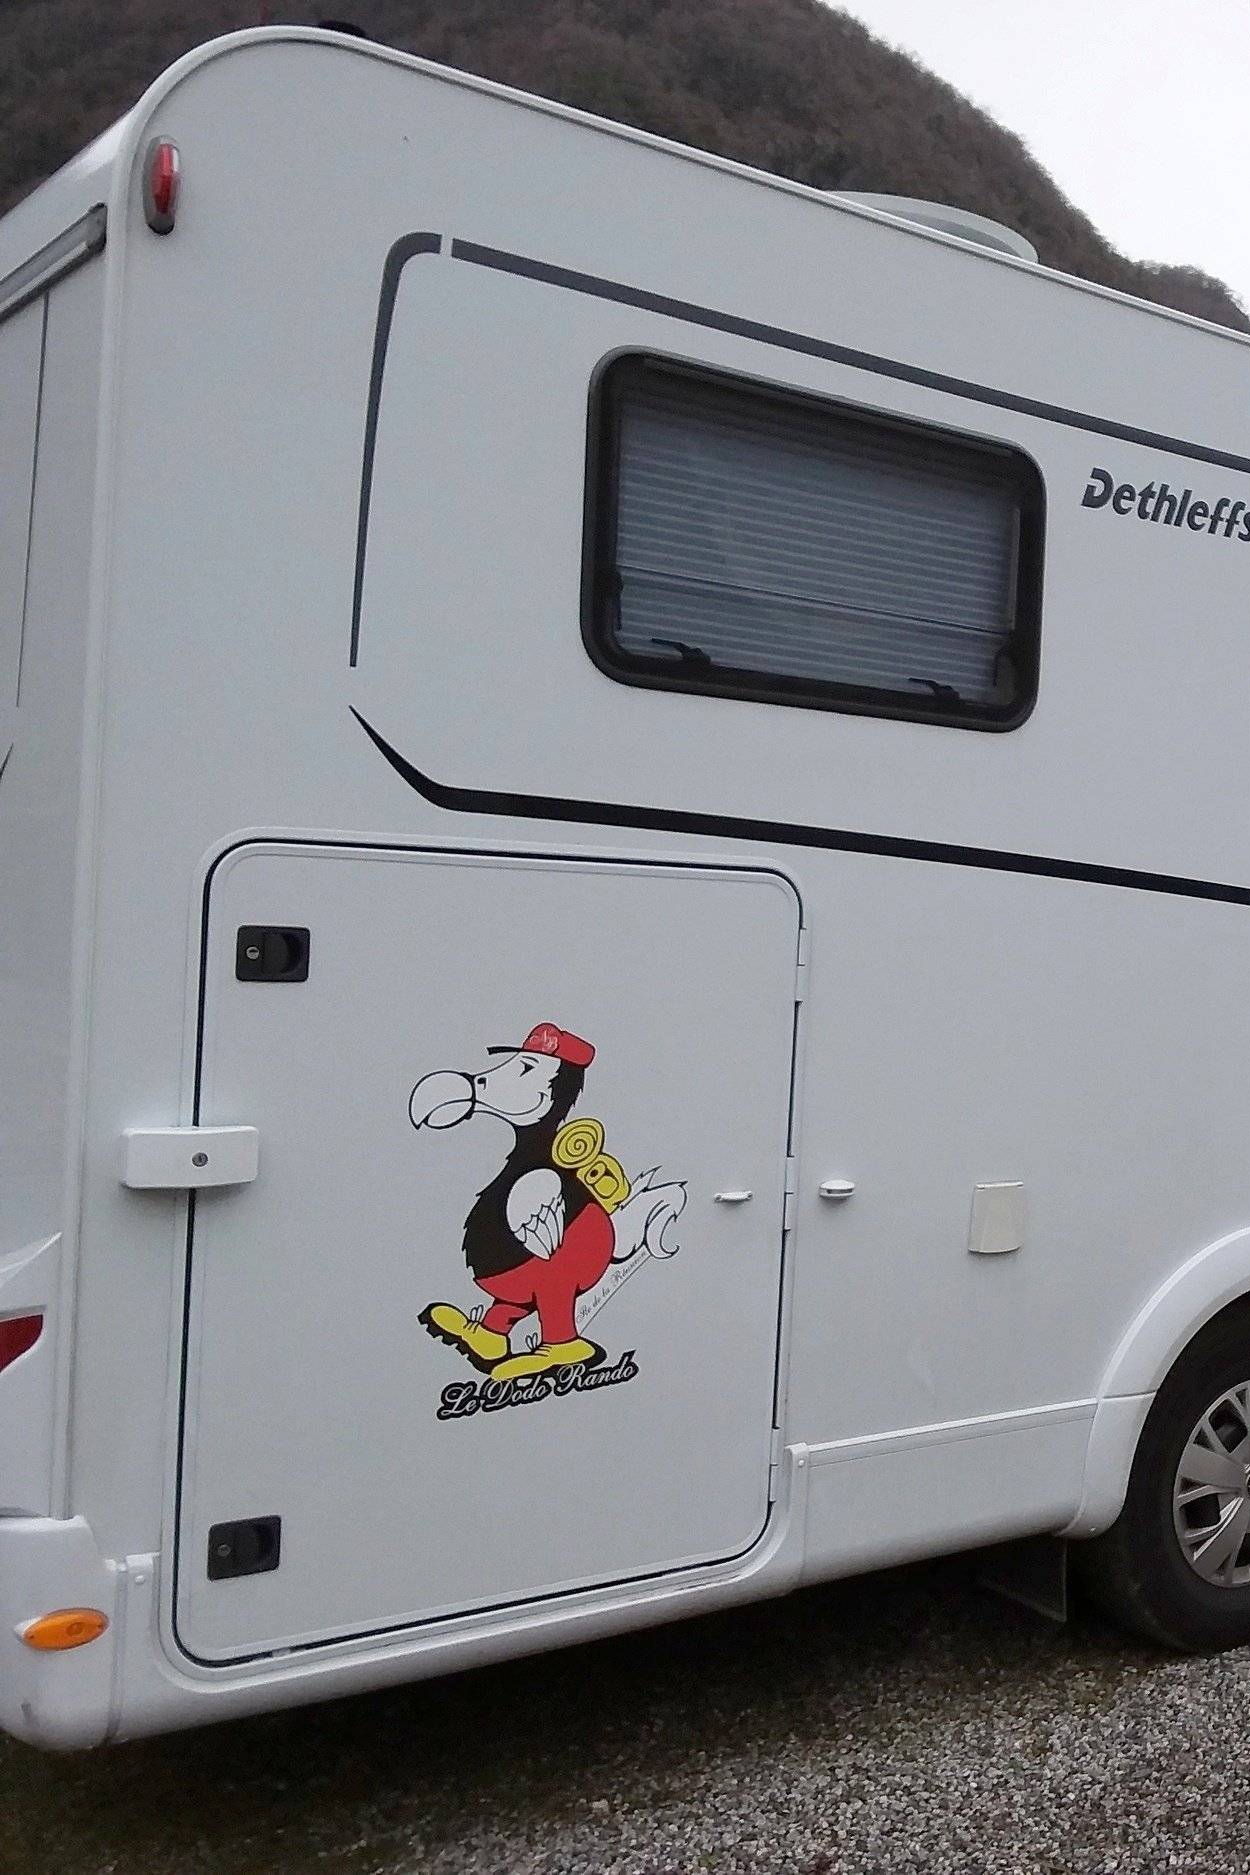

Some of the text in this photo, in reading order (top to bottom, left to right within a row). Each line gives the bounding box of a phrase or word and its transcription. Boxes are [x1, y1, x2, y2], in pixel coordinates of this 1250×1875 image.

[440, 1355, 634, 1416] Le Dodo Rando
